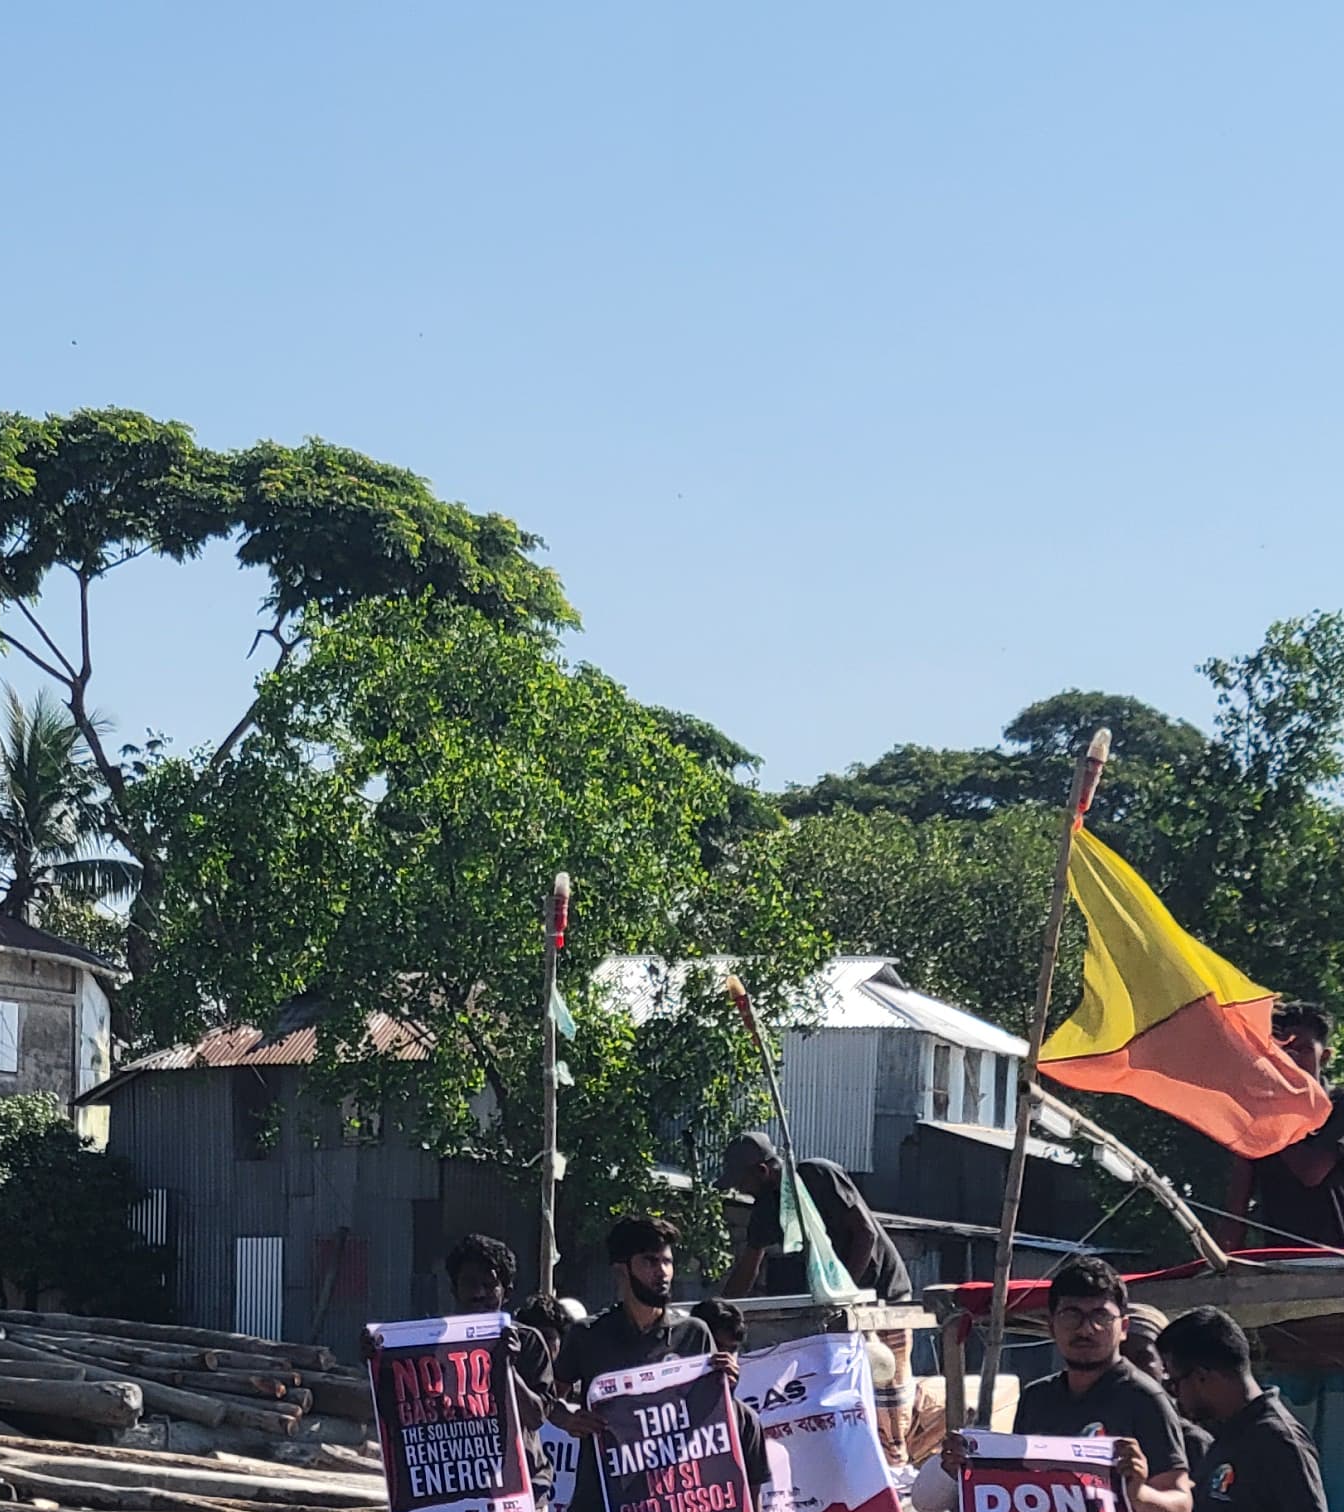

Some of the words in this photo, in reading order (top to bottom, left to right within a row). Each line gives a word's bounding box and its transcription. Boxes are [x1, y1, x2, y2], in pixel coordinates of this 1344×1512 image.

[392, 1355, 444, 1402] NO
[448, 1348, 492, 1395] TO
[398, 1399, 438, 1426] GAS
[457, 1393, 498, 1418] LNG
[633, 1399, 691, 1438] FUEL
[401, 1426, 425, 1444] THE
[427, 1420, 485, 1441] SOLUTION
[487, 1418, 500, 1434] IS
[406, 1435, 503, 1466] RENEWABLE
[542, 1441, 576, 1473] SIL
[607, 1422, 731, 1477] EXPENSIVE
[410, 1456, 505, 1497] ENERGY
[646, 1465, 675, 1497] AN
[679, 1460, 701, 1488] IS
